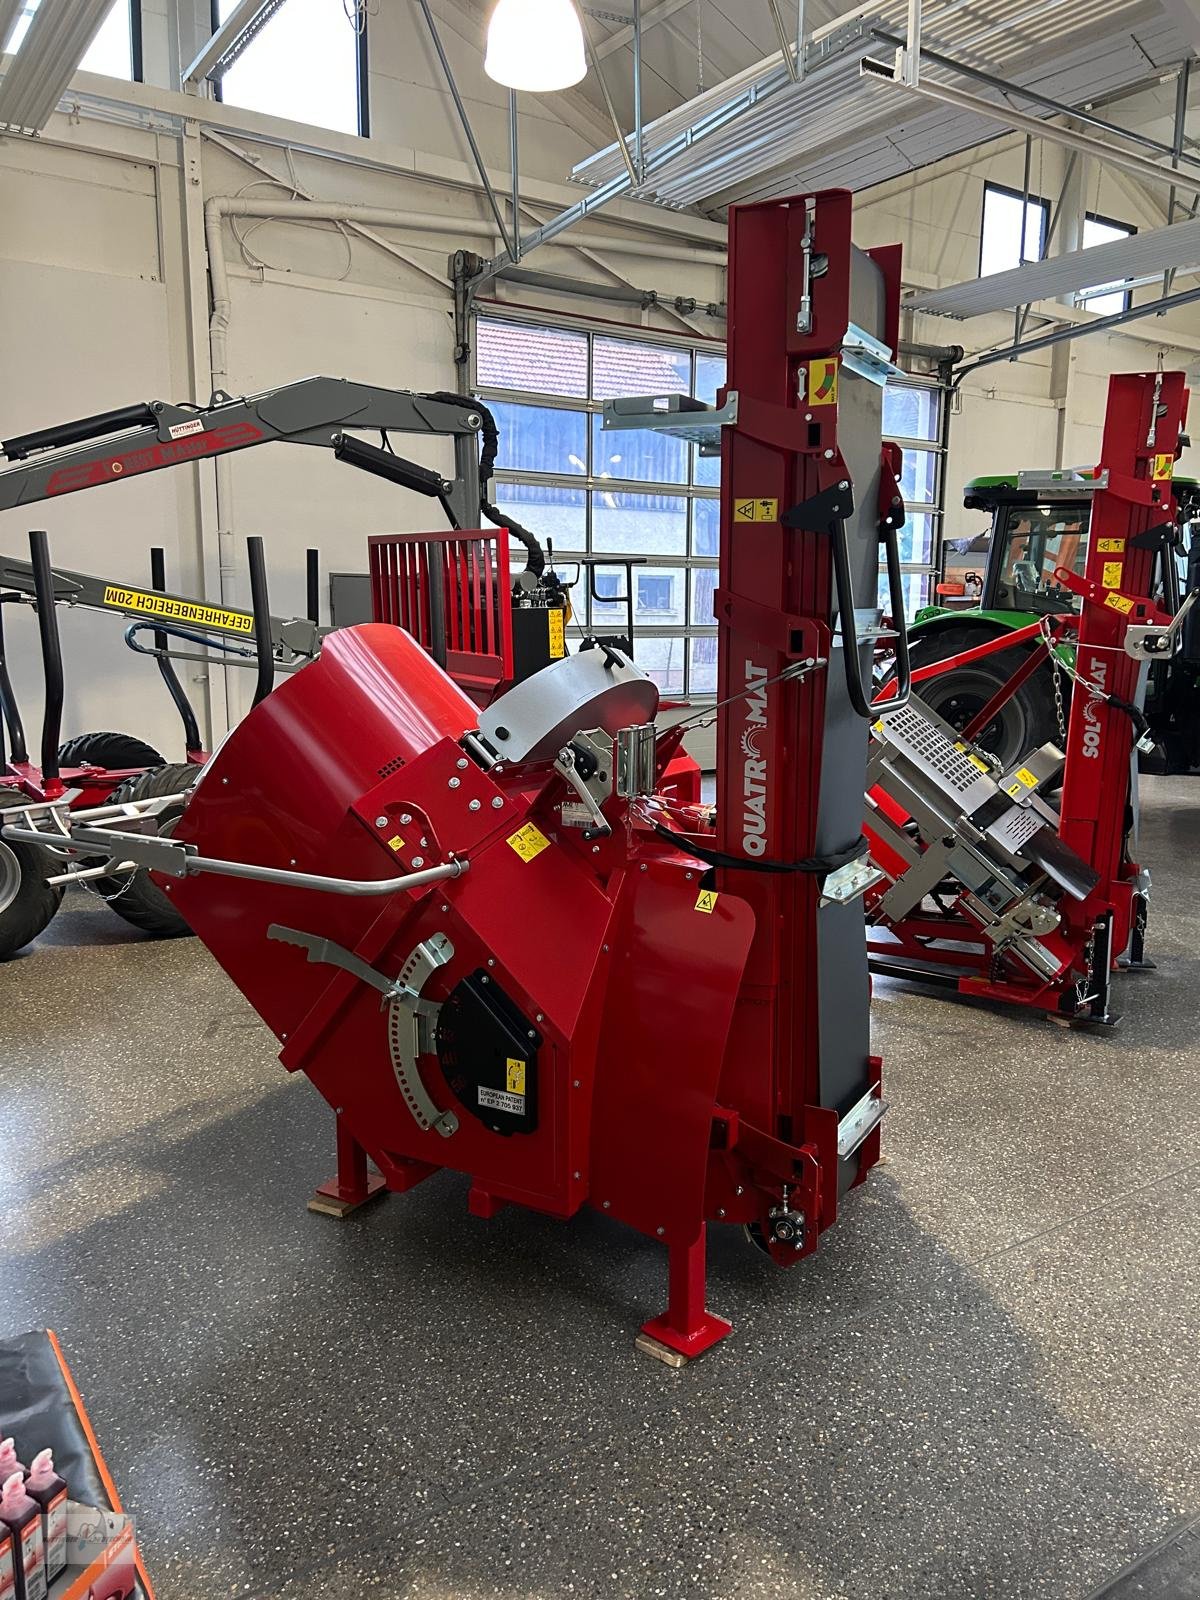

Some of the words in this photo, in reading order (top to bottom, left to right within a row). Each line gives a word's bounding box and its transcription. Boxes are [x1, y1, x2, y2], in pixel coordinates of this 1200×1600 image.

[106, 589, 133, 605] 20M
[136, 595, 251, 630] GEFAHRENBEREICH
[480, 1089, 505, 1101] EUROPEAN
[506, 1095, 522, 1106] PATENT
